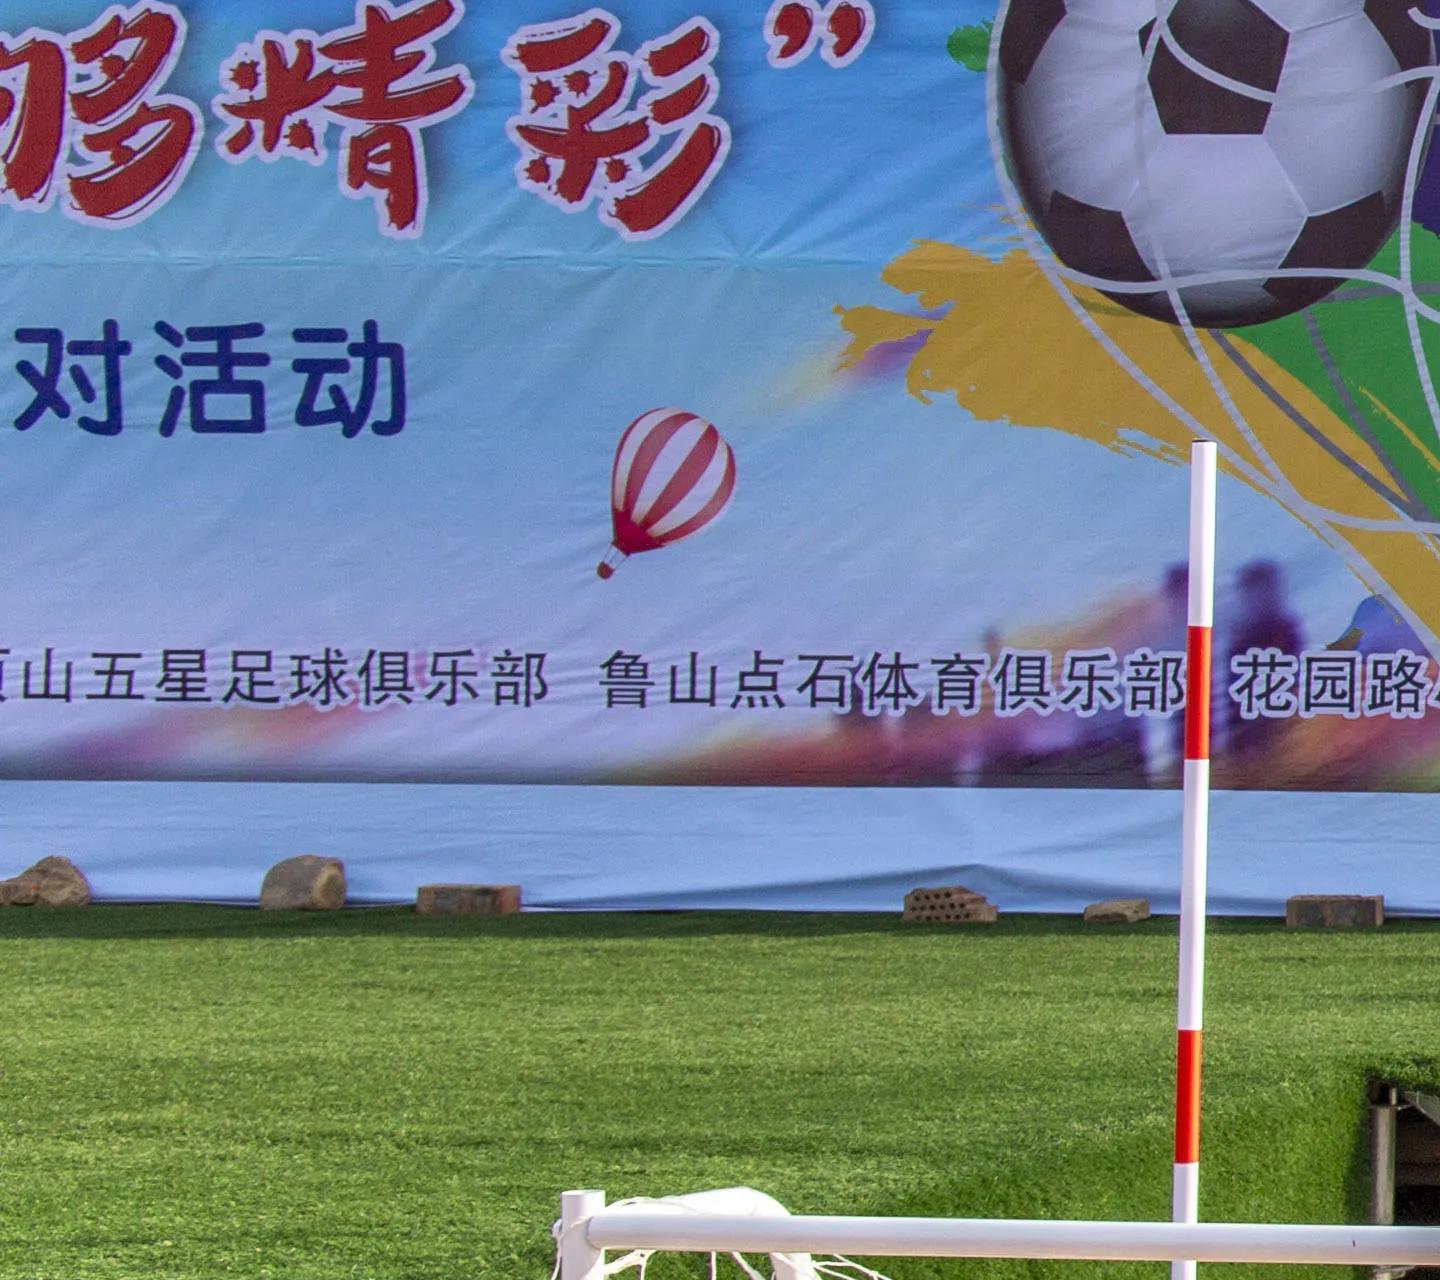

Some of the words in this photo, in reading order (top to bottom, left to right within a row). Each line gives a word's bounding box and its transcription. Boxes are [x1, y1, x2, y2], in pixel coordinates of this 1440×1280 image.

[14, 319, 407, 438] 对活动
[0, 647, 549, 708] 山五星足球俱乐部
[599, 649, 1185, 714] 鲁山点石体育俱乐部
